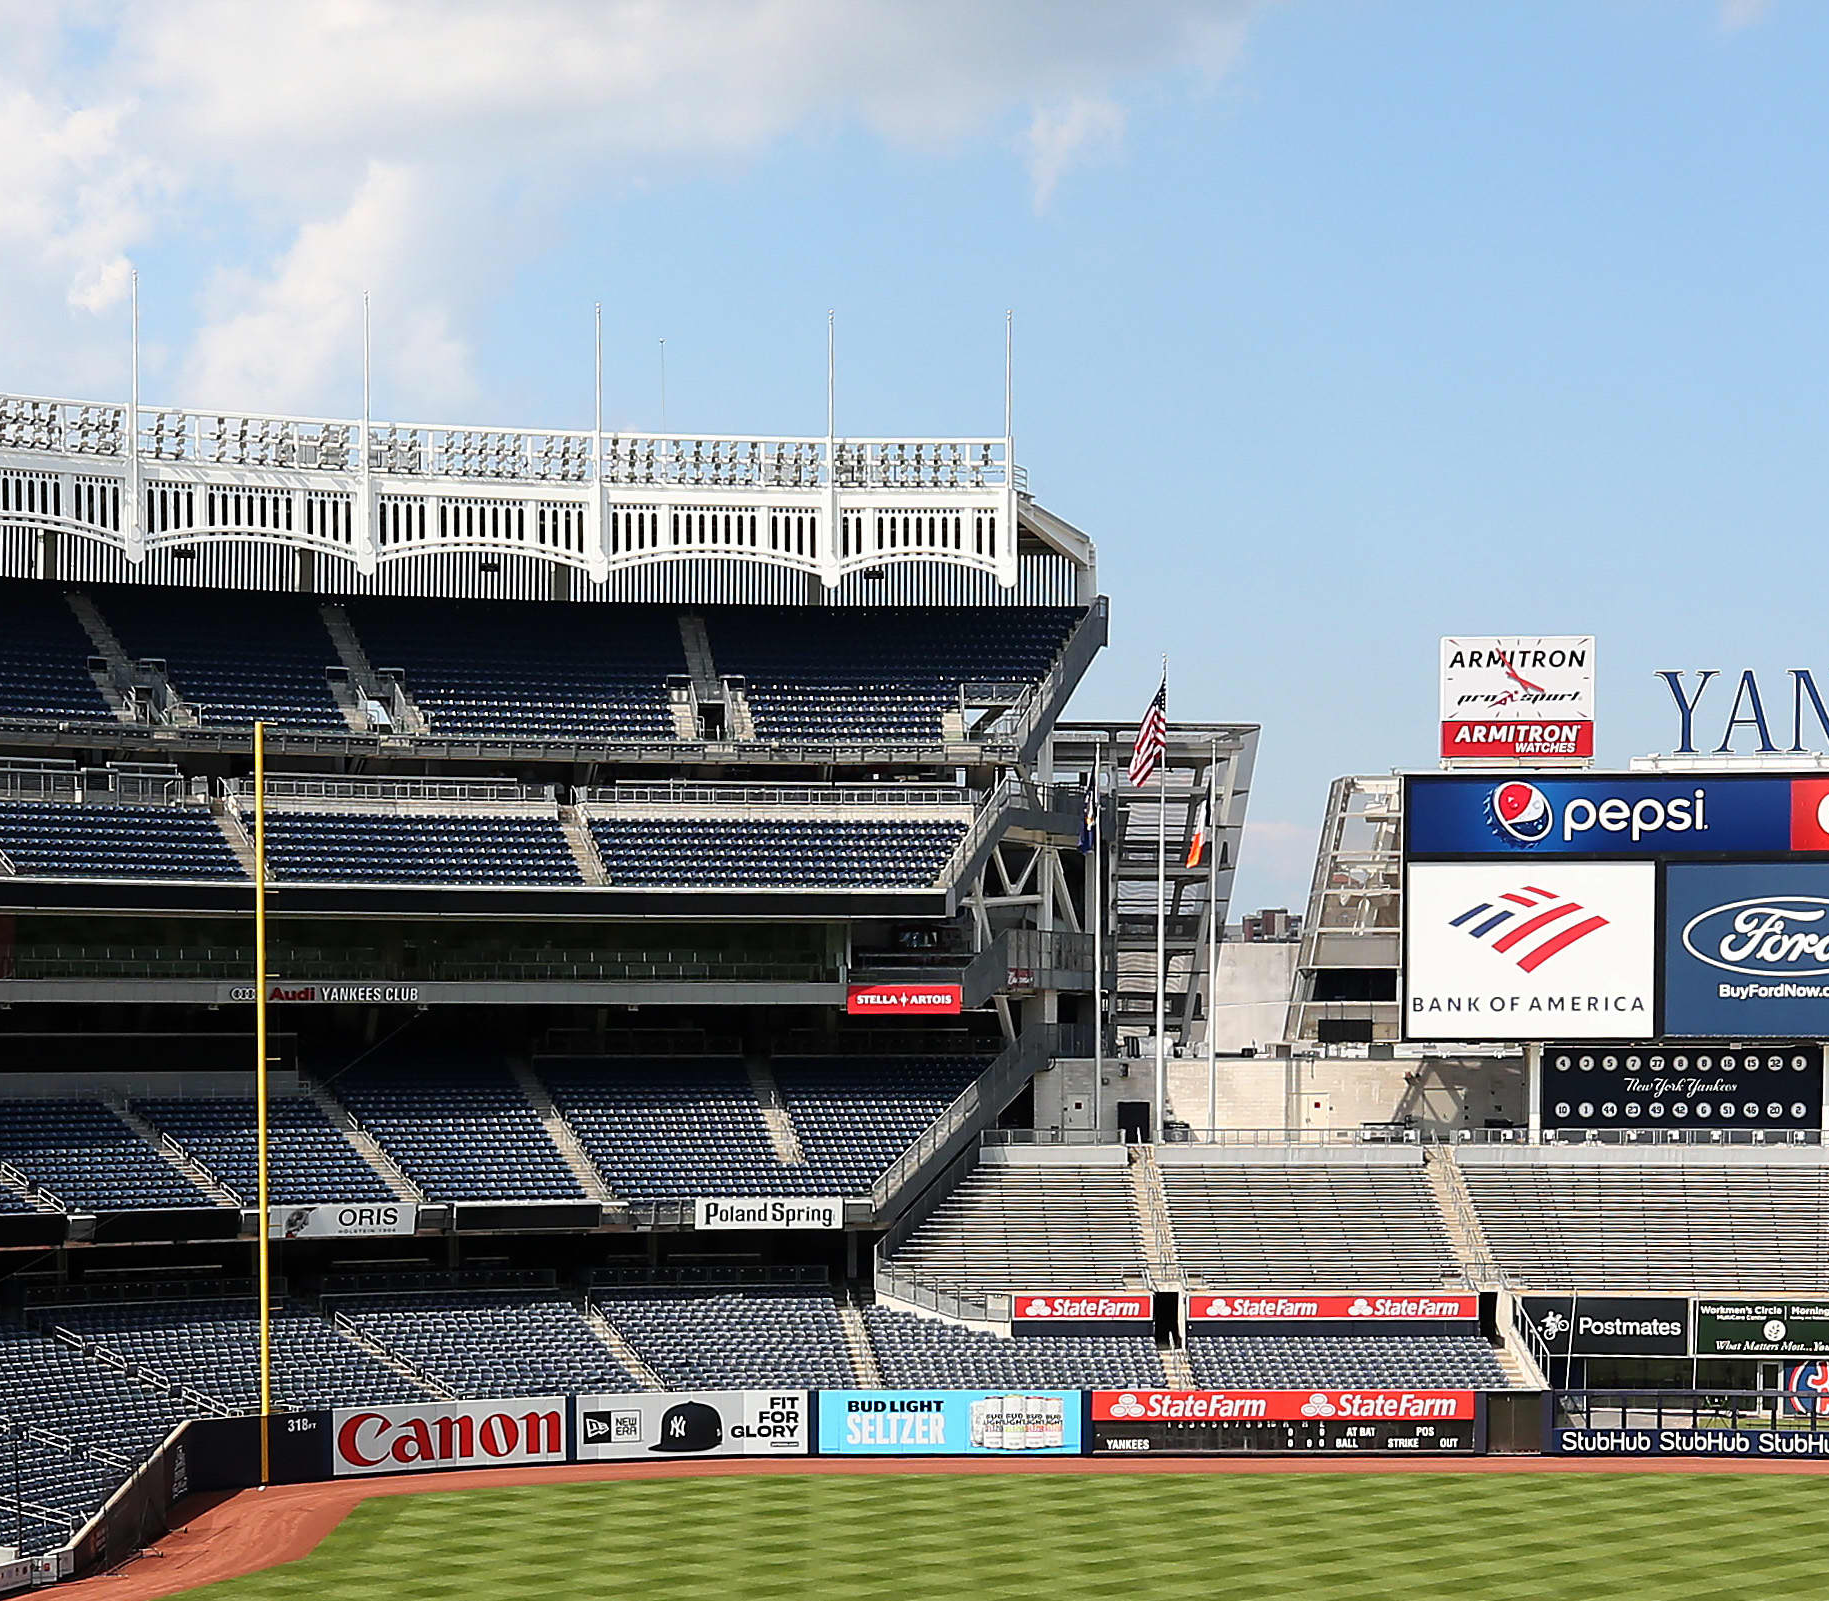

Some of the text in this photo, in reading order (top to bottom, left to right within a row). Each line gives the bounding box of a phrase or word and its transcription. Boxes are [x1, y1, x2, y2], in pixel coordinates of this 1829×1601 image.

[1448, 650, 1586, 669] ARMITRON
[1454, 725, 1579, 743] ARMITRON
[1515, 742, 1576, 753] WATCHES
[1563, 788, 1709, 841] pepsi
[270, 987, 420, 1001] Audi YANKEES CLUB
[856, 995, 953, 1005] STELLA ARTOIS
[1412, 996, 1646, 1012] BANK OF AMERICA
[1624, 1077, 1738, 1098] New York Yankees
[338, 1207, 399, 1227] ORIS
[705, 1203, 833, 1227] Poland Spring
[1700, 1305, 1753, 1315] Workmen's
[1754, 1306, 1783, 1315] Circle
[1579, 1317, 1682, 1336] Postmates
[1715, 1340, 1742, 1351] What
[1743, 1341, 1779, 1352] Matters
[770, 1396, 799, 1409] FIT
[847, 1400, 944, 1413] BUD LIGHT
[615, 1418, 637, 1427] NEW
[759, 1411, 800, 1423] FOR
[615, 1427, 637, 1437] ERA
[730, 1425, 800, 1438] GLORY
[846, 1413, 945, 1445] SELTZER
[1346, 1427, 1377, 1437] AT BAT
[1415, 1427, 1435, 1437] POS
[337, 1410, 563, 1467] Canon
[1106, 1439, 1150, 1450] YANKEES
[1335, 1438, 1359, 1449] BALL
[1387, 1438, 1420, 1449] STRIKE
[1439, 1438, 1459, 1449] OUT
[1562, 1431, 1652, 1452] StubHub
[1659, 1431, 1750, 1453] StubHub
